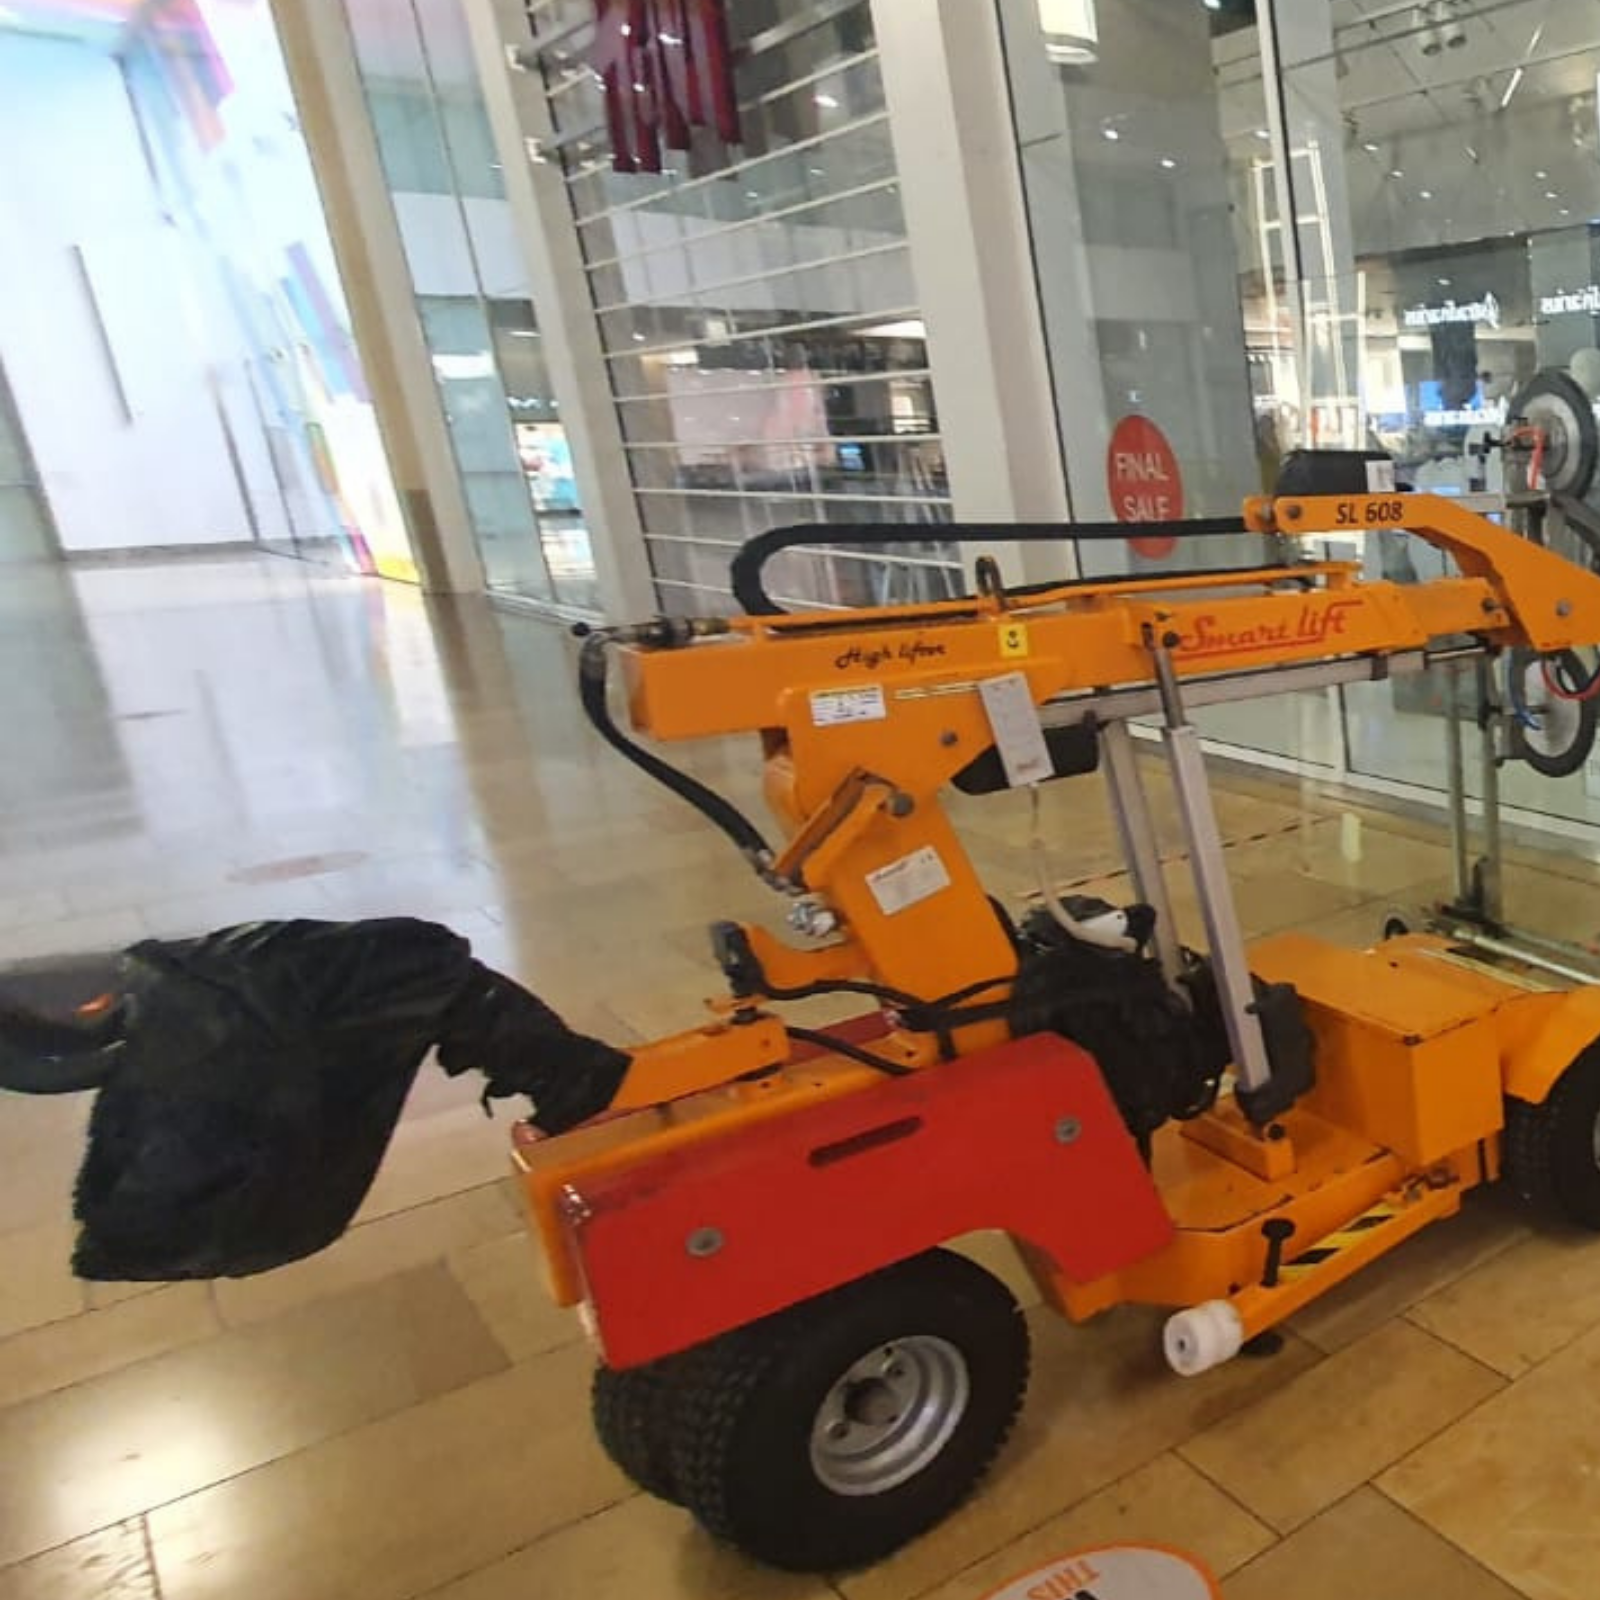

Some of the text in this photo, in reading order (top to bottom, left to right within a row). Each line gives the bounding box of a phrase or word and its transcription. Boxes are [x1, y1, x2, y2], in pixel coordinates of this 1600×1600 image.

[1116, 452, 1170, 482] FINAL
[1122, 495, 1172, 523] SALE
[1335, 500, 1403, 525] SL 608
[1179, 600, 1364, 652] Smart lift
[833, 645, 892, 670] High
